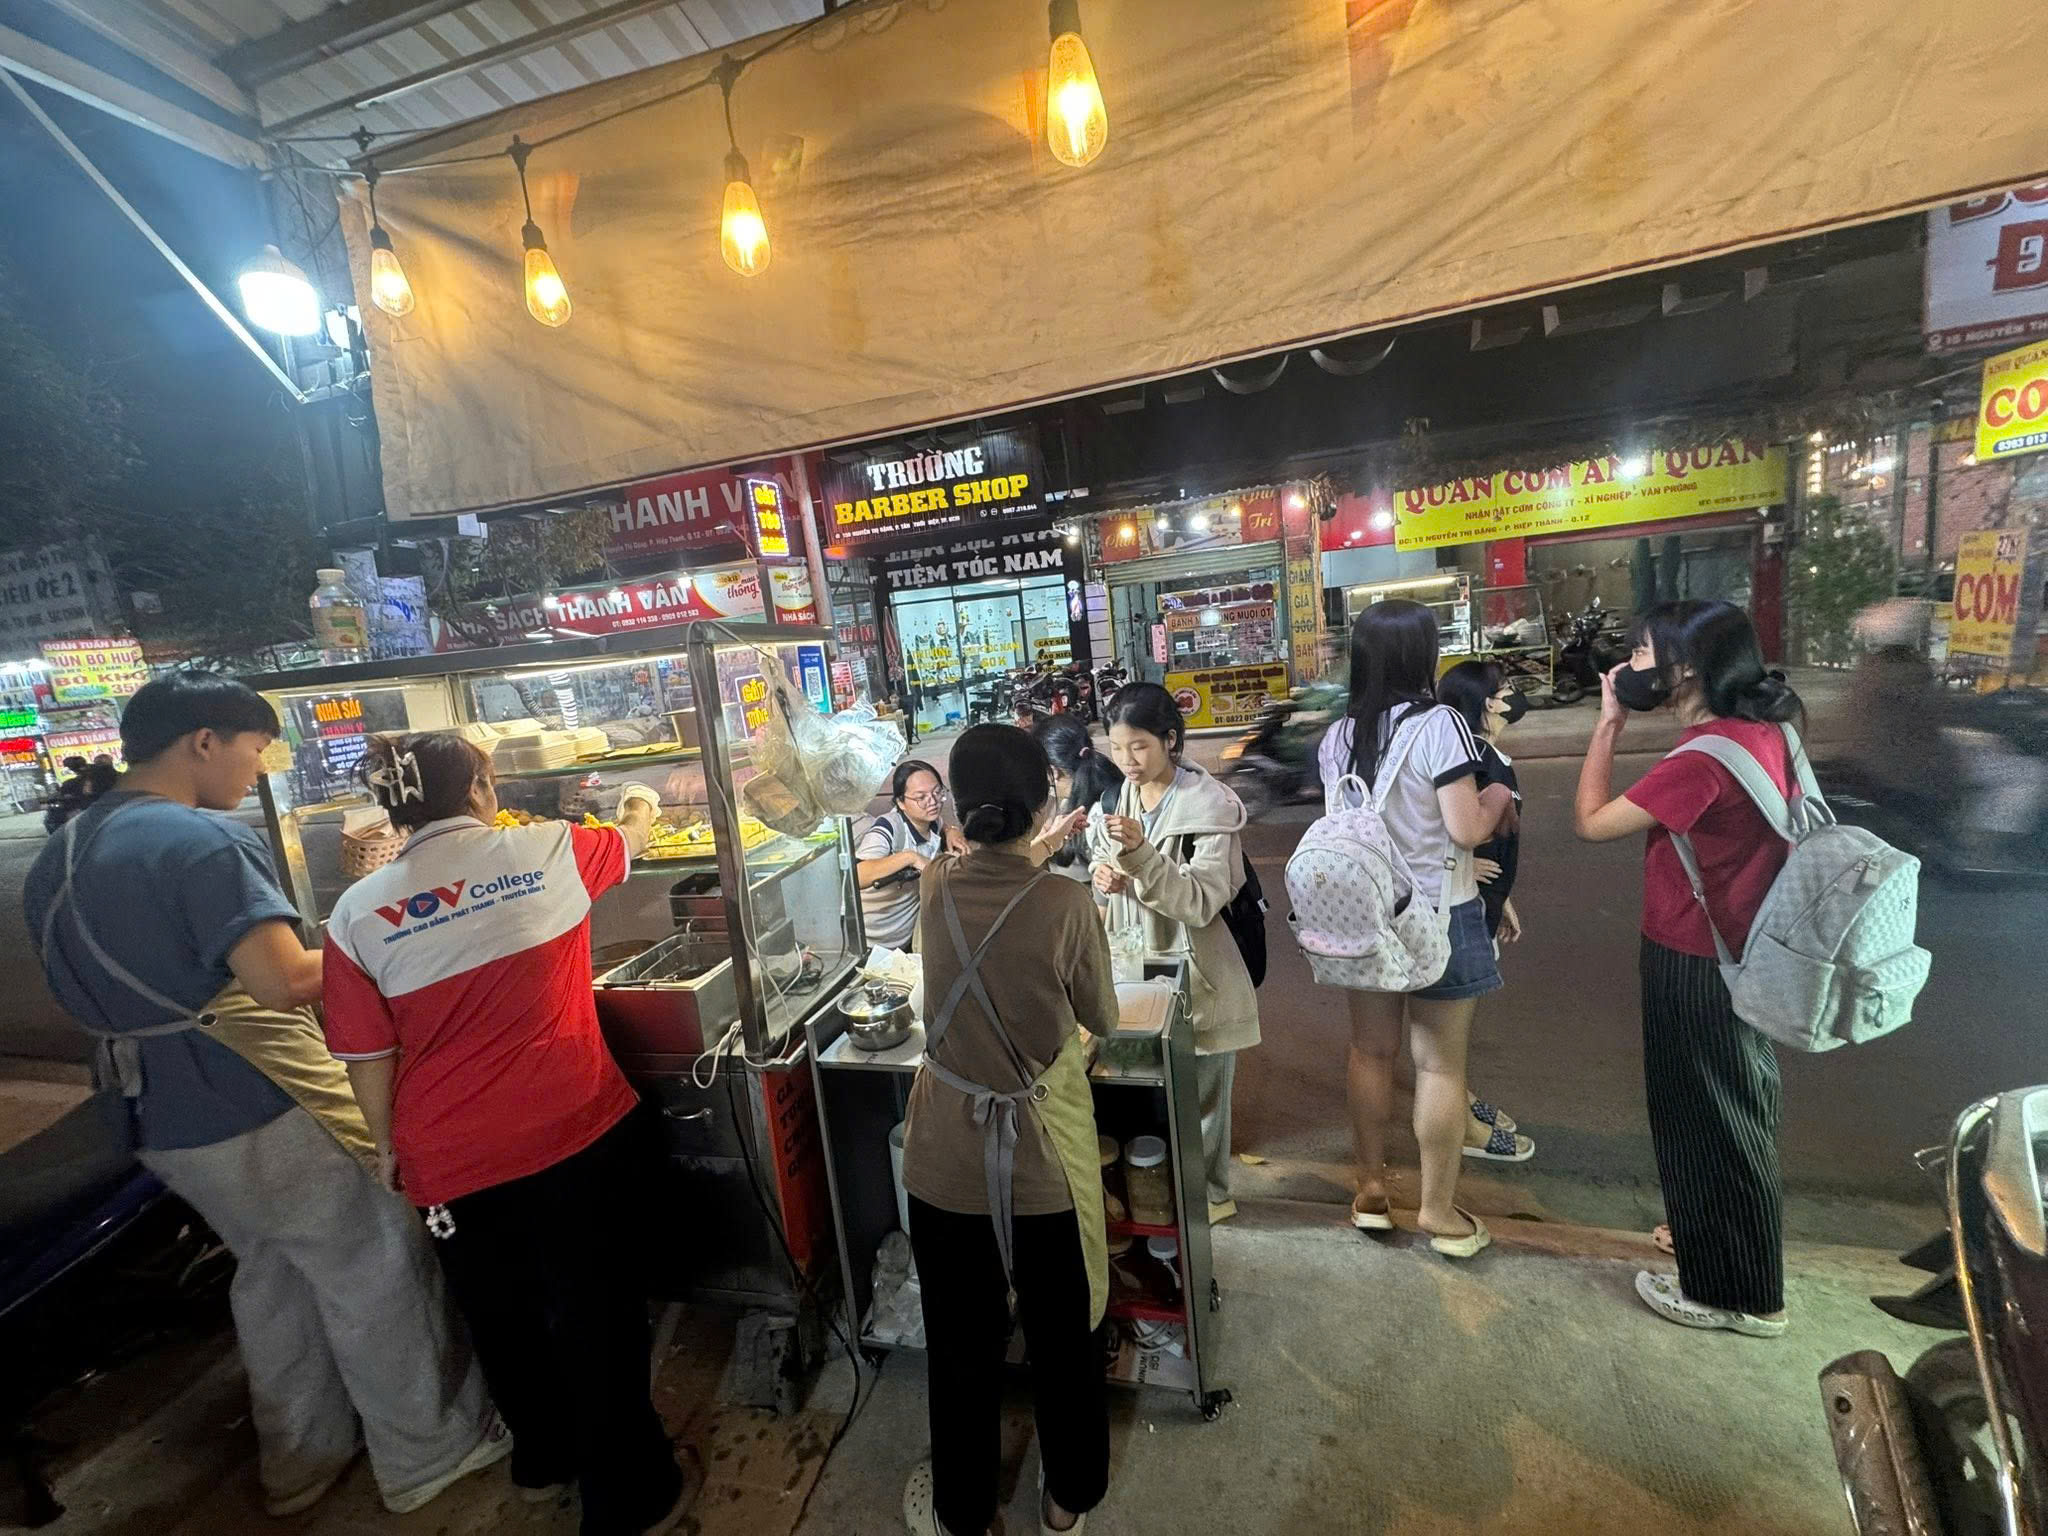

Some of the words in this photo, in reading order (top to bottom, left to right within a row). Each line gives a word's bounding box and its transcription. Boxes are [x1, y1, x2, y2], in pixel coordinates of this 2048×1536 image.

[867, 447, 984, 491] TRƯỜNG
[609, 486, 710, 532] HANH
[834, 487, 949, 525] BARBER
[953, 474, 1029, 506] SHOP
[887, 564, 948, 588] TIỆM
[952, 555, 998, 580] TÓC
[1003, 549, 1064, 573] NAM
[556, 591, 632, 622] THANH
[637, 583, 689, 611] VÂN
[315, 698, 343, 722] NHÀ
[469, 870, 544, 899] College
[413, 922, 429, 934] CAO
[451, 906, 470, 920] PHÁT
